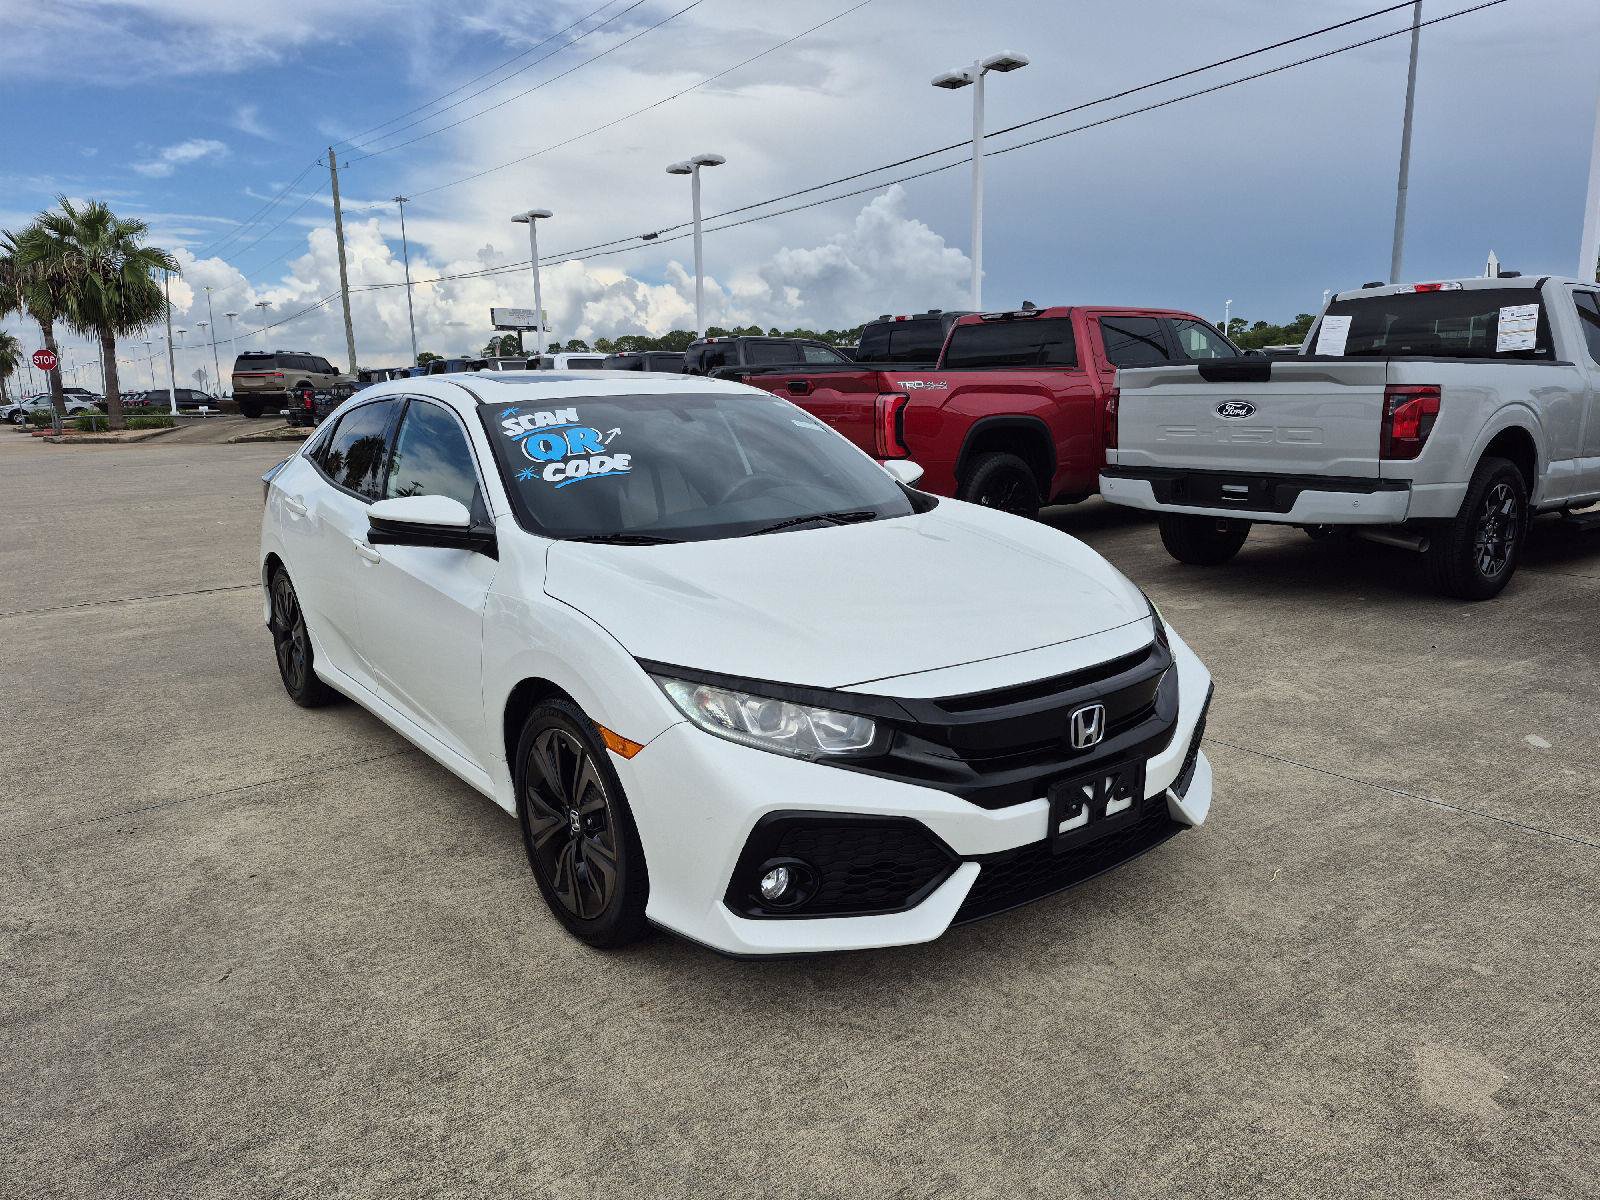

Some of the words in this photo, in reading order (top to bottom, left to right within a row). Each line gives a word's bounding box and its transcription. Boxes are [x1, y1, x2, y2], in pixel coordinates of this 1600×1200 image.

[33, 355, 56, 365] STOP
[1222, 403, 1249, 416] Ford
[501, 407, 579, 437] SCAN
[542, 453, 633, 482] CODE
